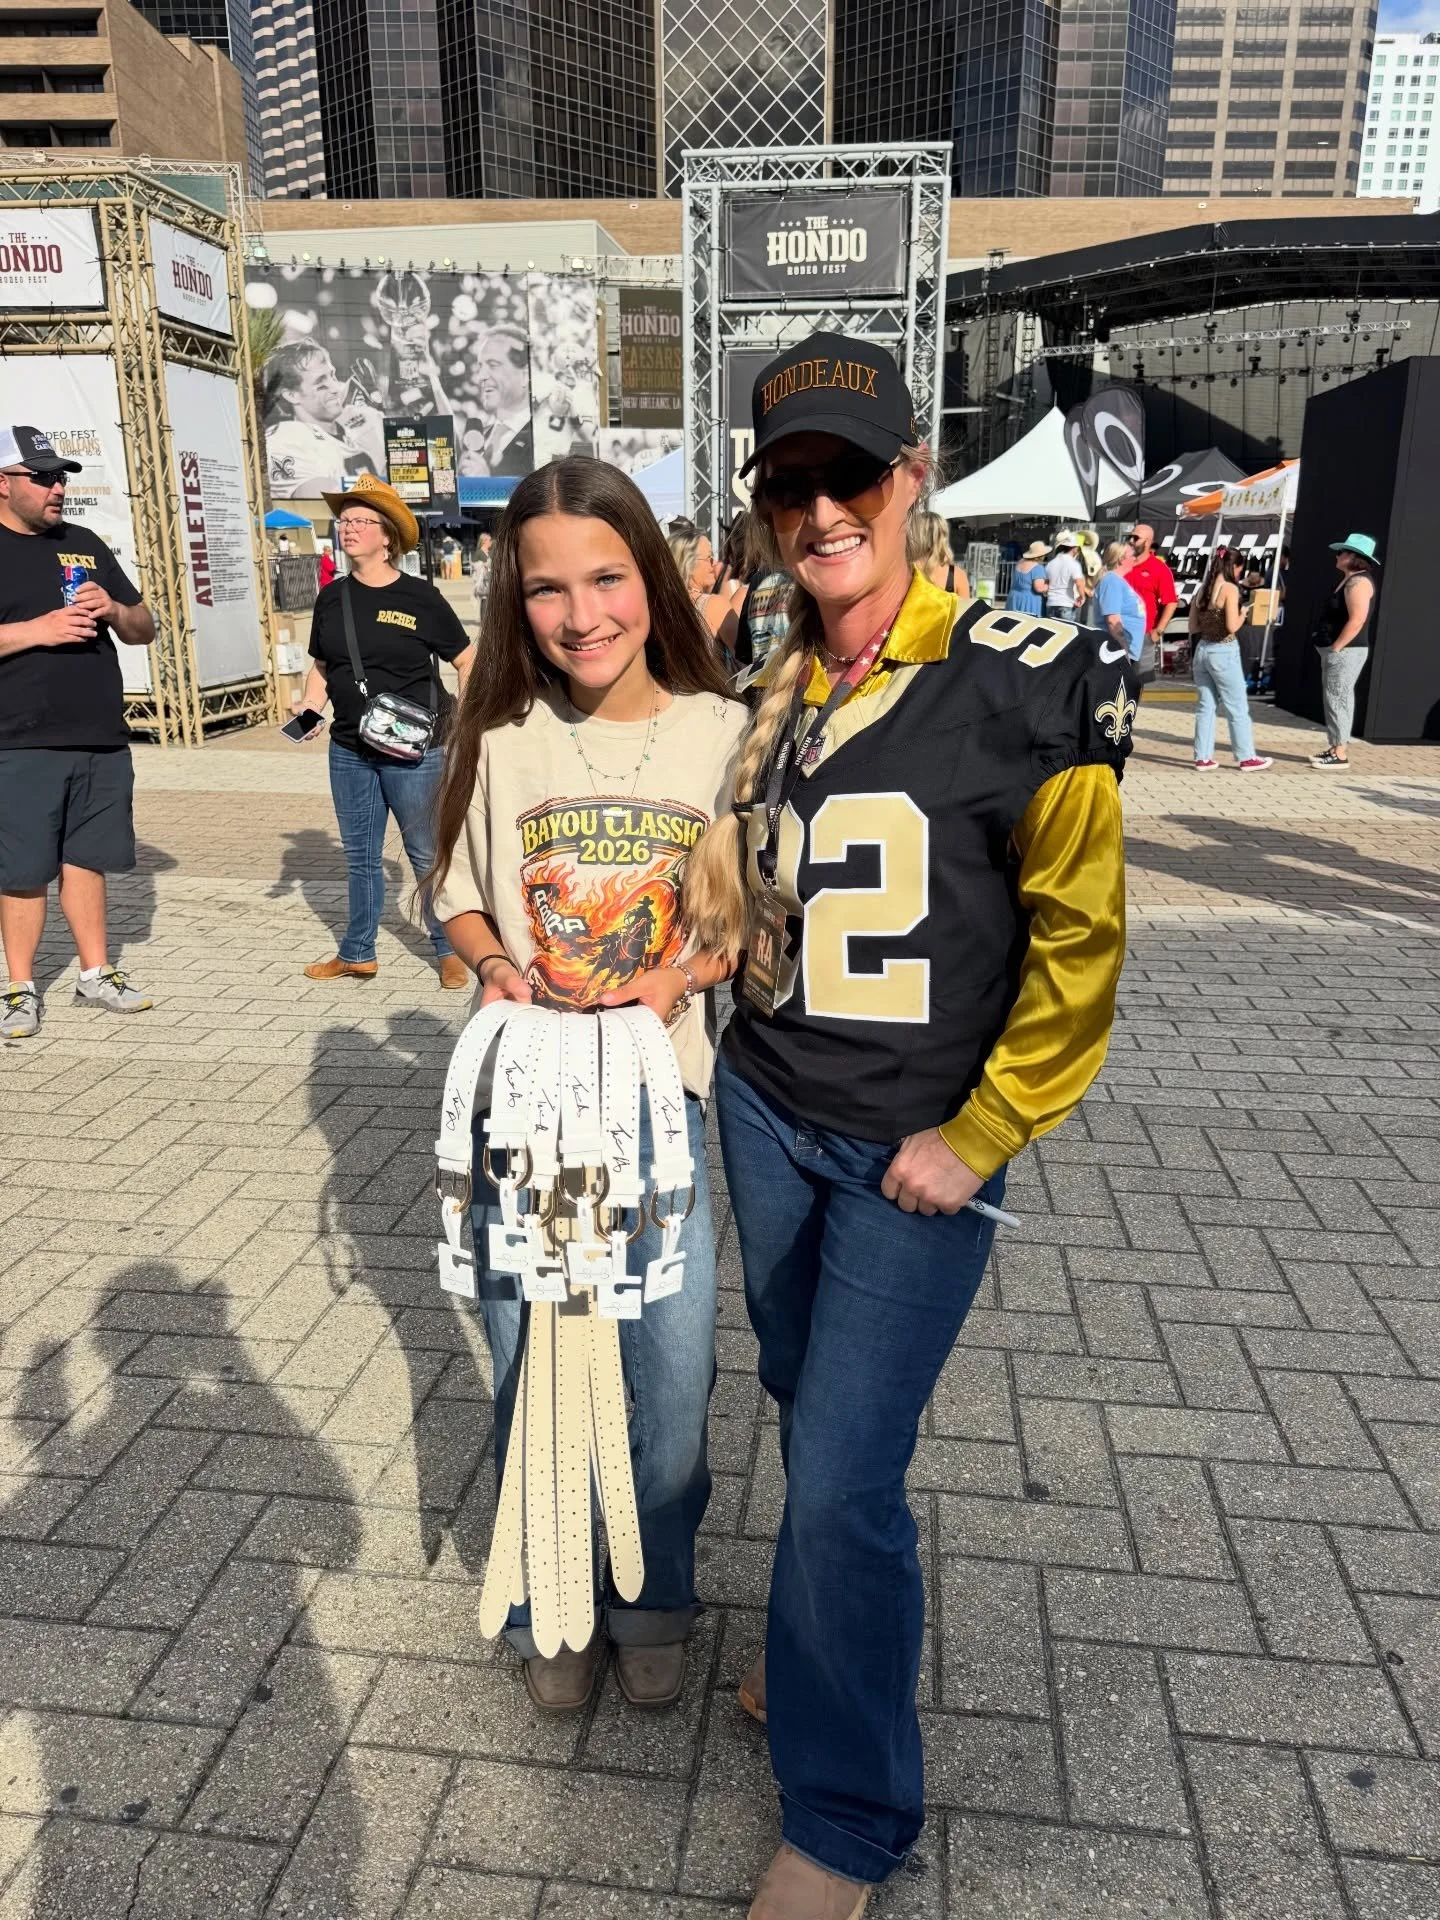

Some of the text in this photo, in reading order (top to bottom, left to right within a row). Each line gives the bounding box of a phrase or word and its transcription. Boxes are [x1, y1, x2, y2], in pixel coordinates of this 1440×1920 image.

[806, 216, 829, 230] THE
[8, 232, 28, 243] THE
[767, 228, 867, 266] HONDO
[0, 244, 63, 273] ONDO
[787, 263, 847, 276] RODEO FEST
[28, 275, 48, 284] FEST
[172, 260, 213, 301] HONDO
[644, 305, 657, 315] THE
[620, 313, 681, 337] HONDO
[620, 346, 682, 369] CAESARS
[761, 359, 879, 416] HONDEAUX
[620, 396, 638, 409] NEW
[45, 430, 97, 441] DEO FEST
[73, 497, 98, 506] DANIELS
[180, 457, 213, 608] ATHLETES
[57, 552, 98, 570] RICKY
[376, 609, 417, 631] RACHEL
[524, 806, 706, 855] BAYOU CLASSIC
[579, 839, 650, 863] 2026
